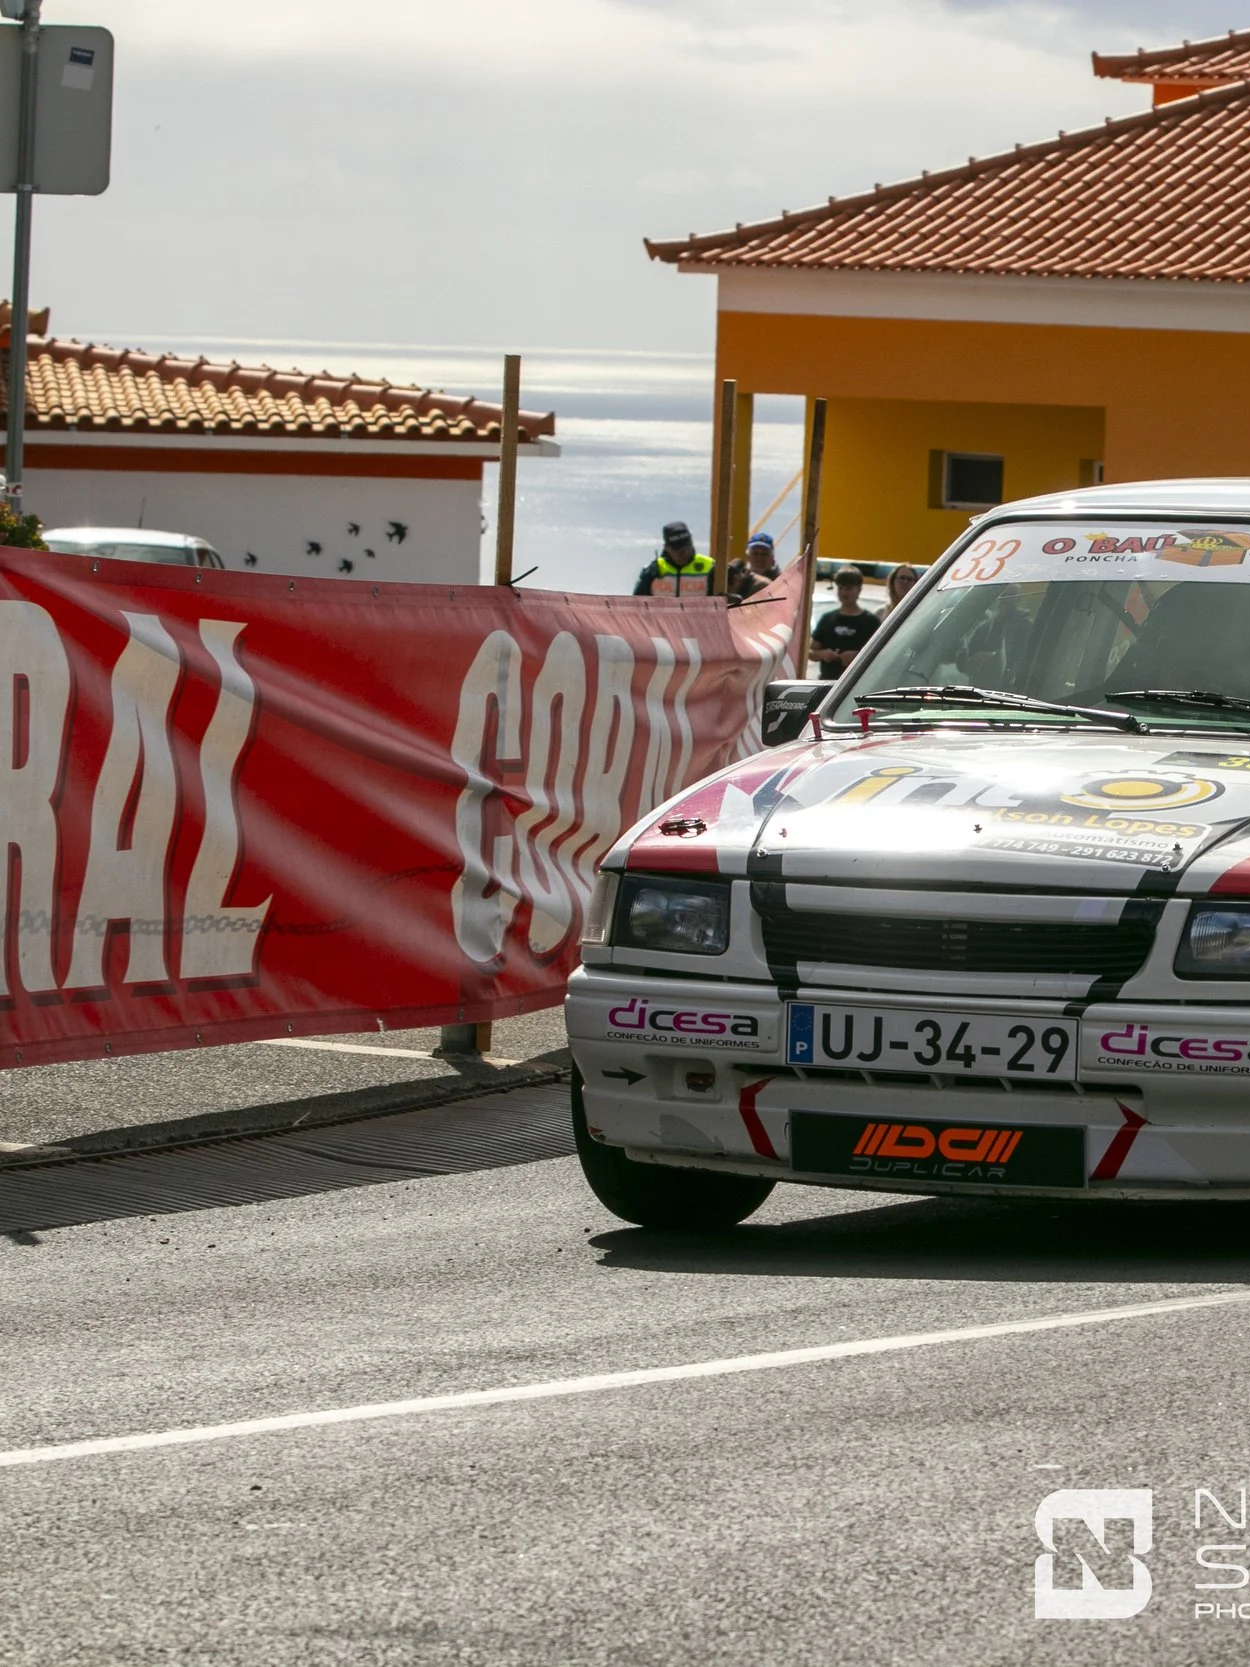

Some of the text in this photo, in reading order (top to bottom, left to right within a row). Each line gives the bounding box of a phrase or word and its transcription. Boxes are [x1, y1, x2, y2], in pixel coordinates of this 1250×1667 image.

[1042, 537, 1077, 555] O
[951, 539, 1022, 582] 33
[1064, 555, 1138, 563] PONCHA
[1083, 815, 1198, 838] Lopes
[1028, 841, 1058, 853] 749
[1071, 846, 1102, 858] 291
[1107, 849, 1137, 861] 623
[1141, 853, 1174, 865] 872
[608, 998, 759, 1036] dicesa
[607, 1031, 760, 1049] CONFEÇÃO DE UNIFORMES
[796, 1013, 1069, 1074] P UJ-34-29
[1098, 1056, 1173, 1070] CONFEÇÃO
[1176, 1063, 1195, 1071] DE
